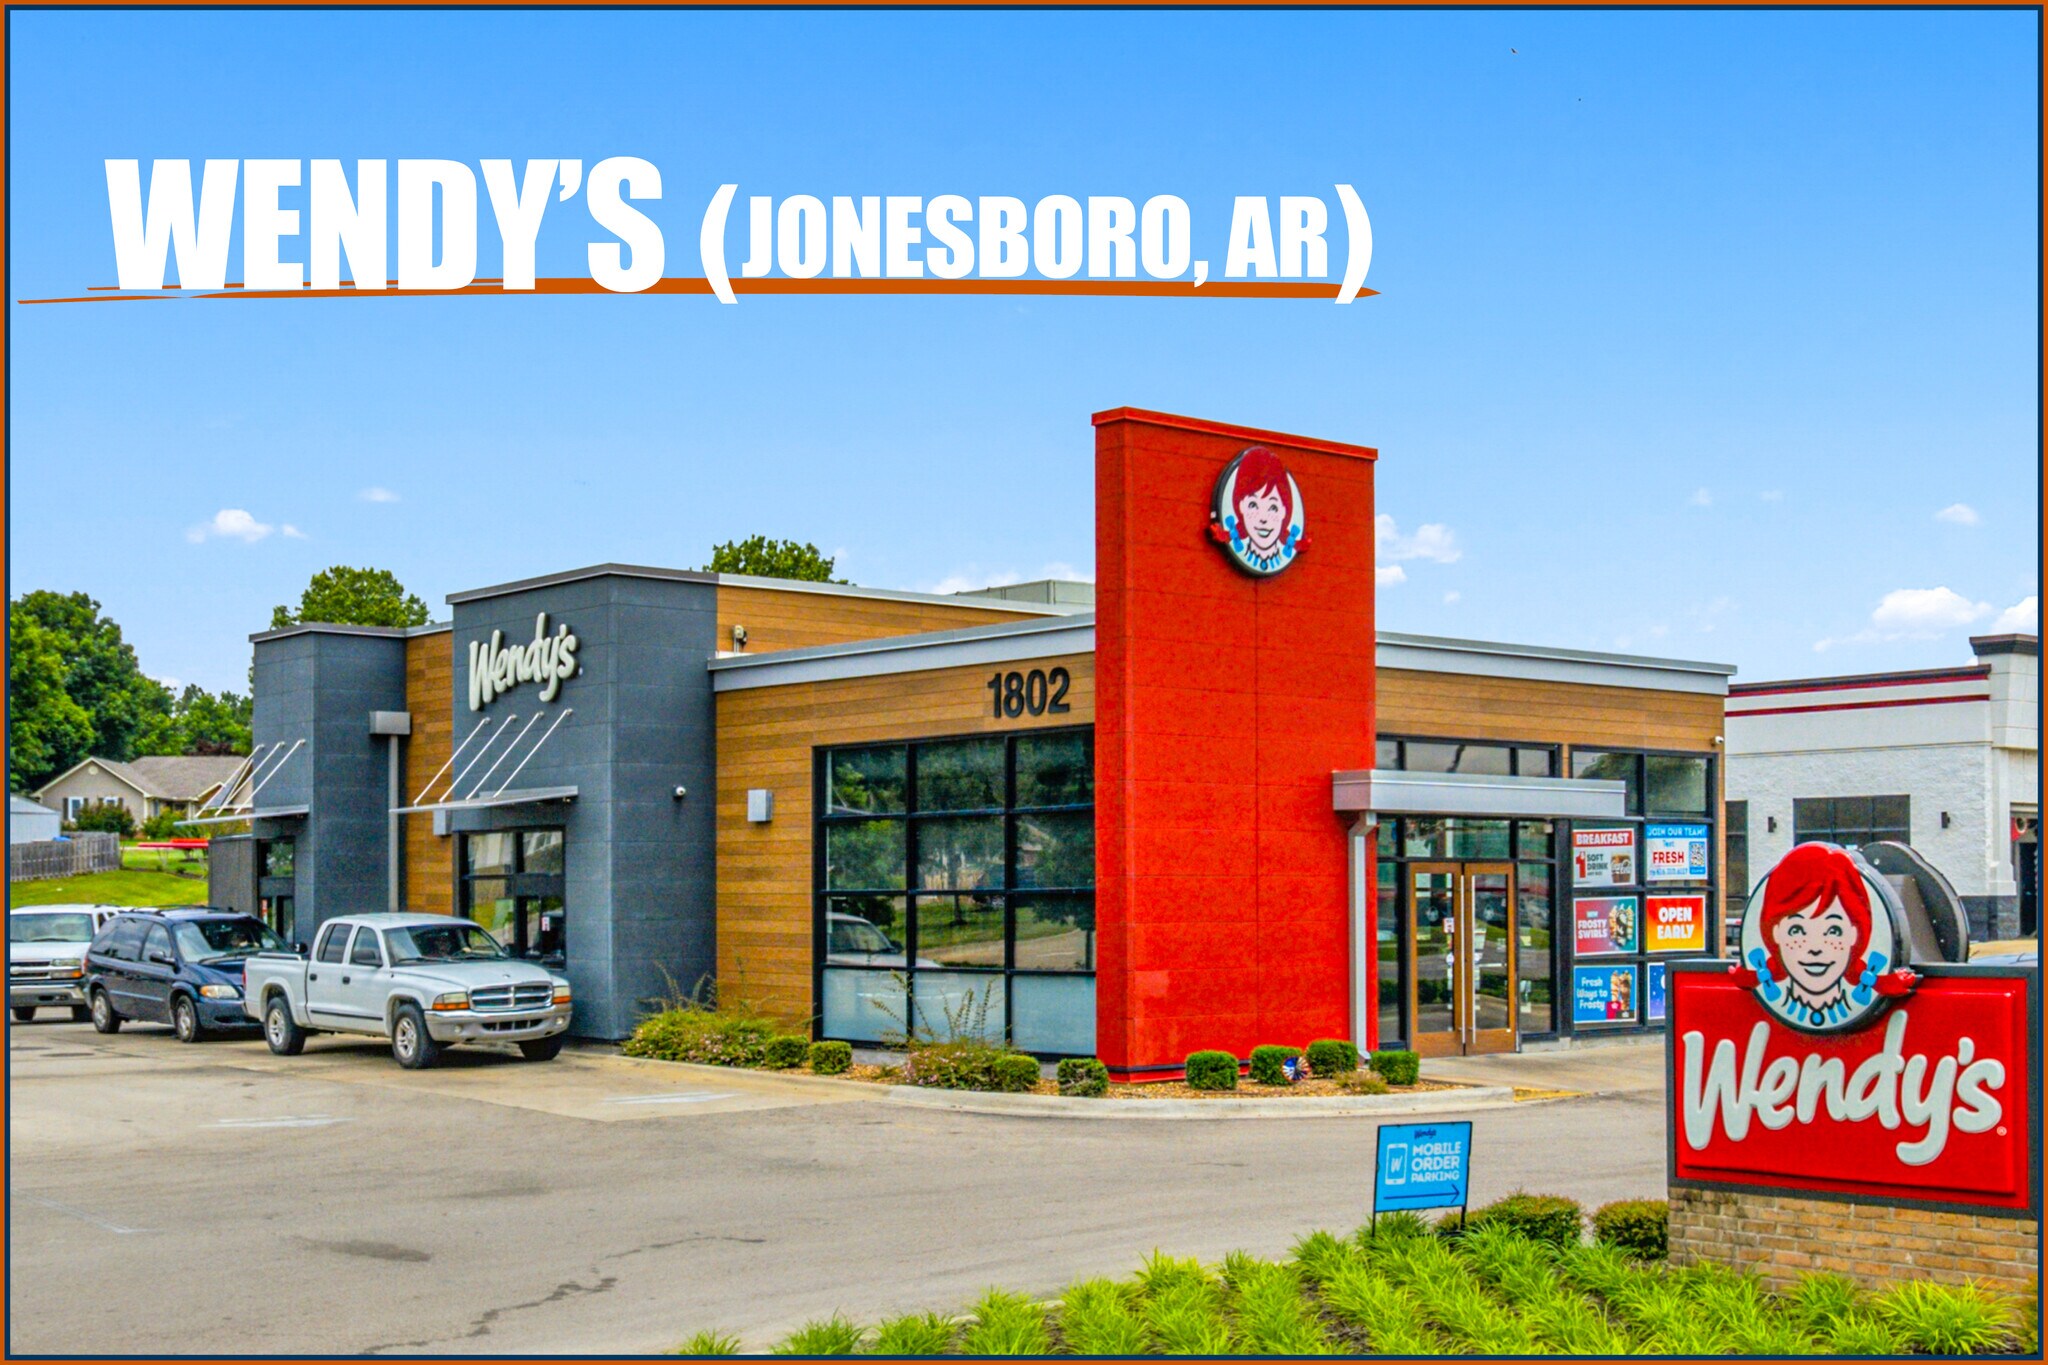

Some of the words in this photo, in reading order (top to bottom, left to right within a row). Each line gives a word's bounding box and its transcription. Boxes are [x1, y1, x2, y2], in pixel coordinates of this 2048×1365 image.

[469, 611, 577, 712] Wendy's
[987, 666, 1070, 719] 1802
[1667, 827, 1683, 836] OUR
[1576, 832, 1630, 845] BREAKFAST
[1586, 853, 1604, 861] SOFT
[1653, 851, 1684, 863] FRESH
[1586, 862, 1608, 871] DRINK
[1659, 907, 1692, 922] OPEN
[1578, 919, 1607, 929] FROSTY
[1578, 929, 1608, 939] SWIRLS
[1657, 925, 1694, 938] EARLY
[1581, 976, 1603, 987] Fresh
[1576, 988, 1598, 1000] Ways
[1599, 989, 1608, 998] to
[1579, 999, 1606, 1012] Frosty
[1682, 1009, 2005, 1166] Wendy's
[1412, 1142, 1461, 1156] MOBILE
[1411, 1156, 1460, 1171] ORDER
[1411, 1171, 1459, 1183] PARKING
